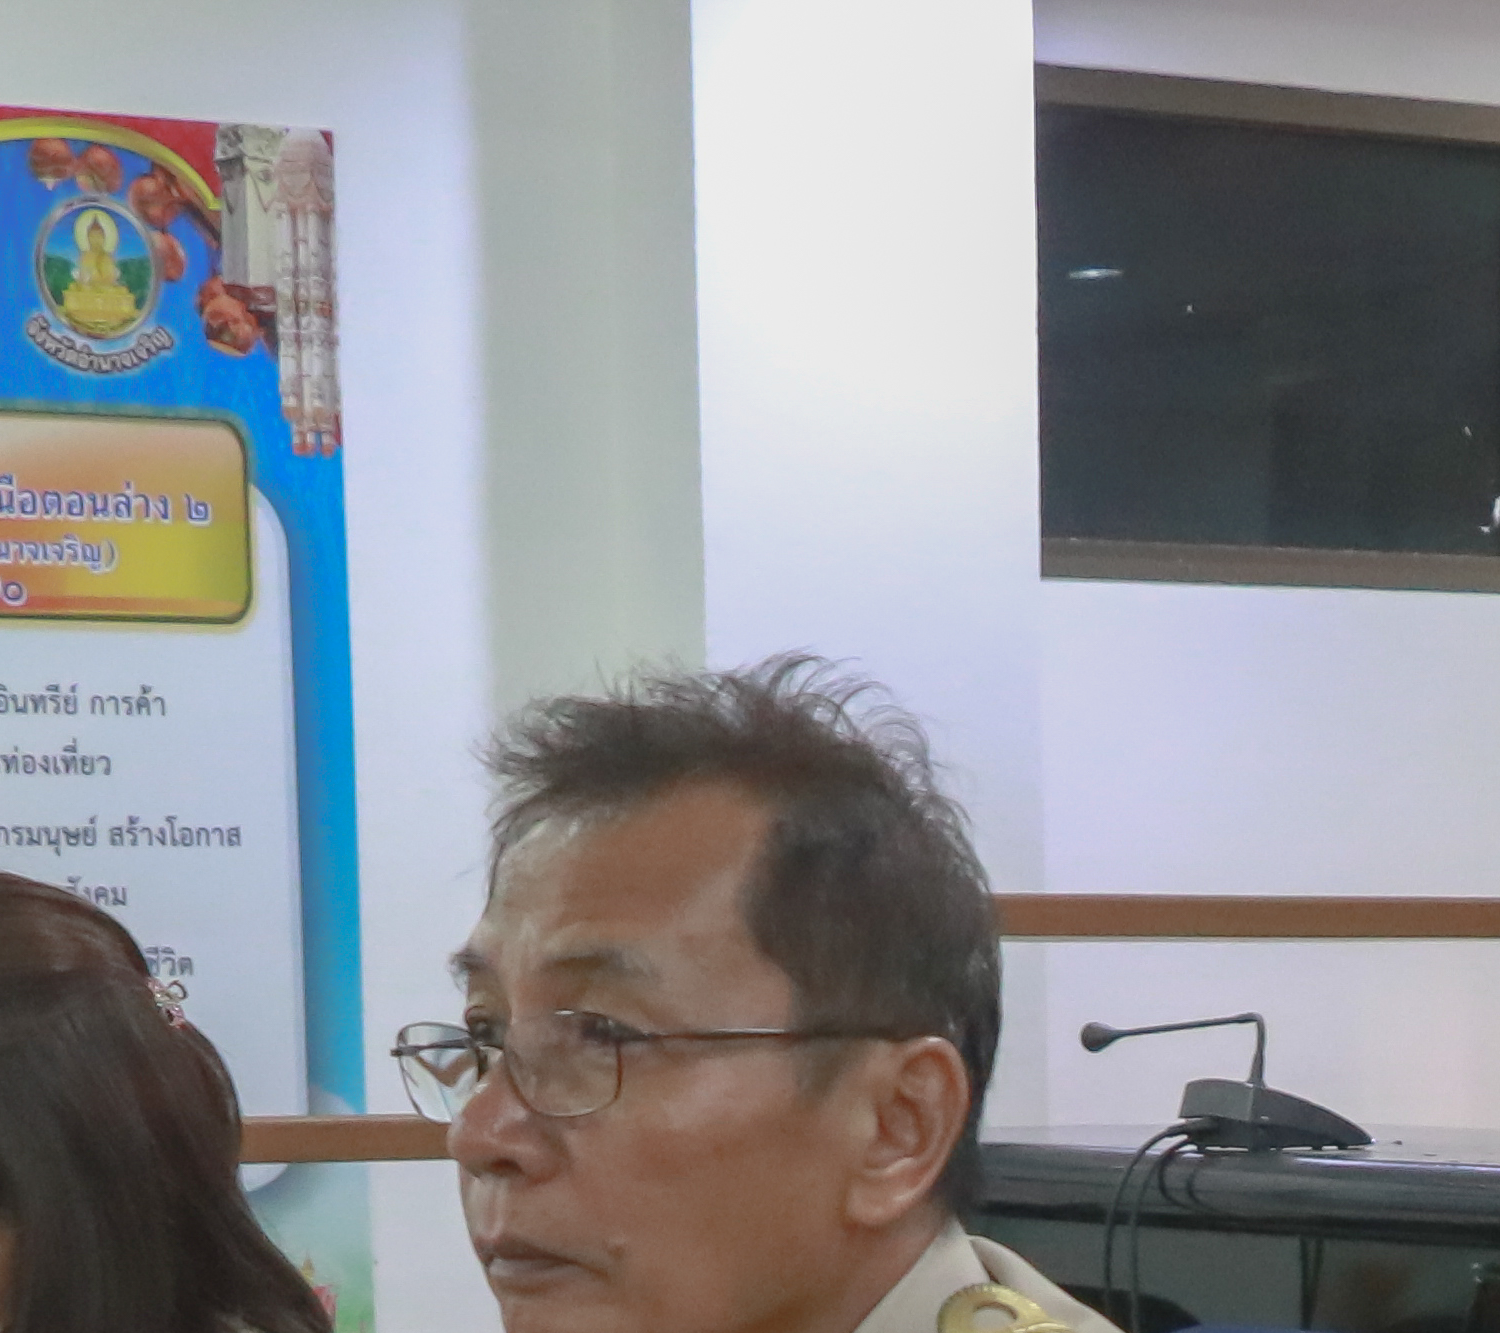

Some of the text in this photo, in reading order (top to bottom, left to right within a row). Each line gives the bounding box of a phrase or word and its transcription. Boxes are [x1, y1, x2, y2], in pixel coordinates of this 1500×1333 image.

[185, 493, 213, 526] ๒
[90, 684, 166, 718] การค้า
[109, 816, 242, 848] สร้างโอกาส
